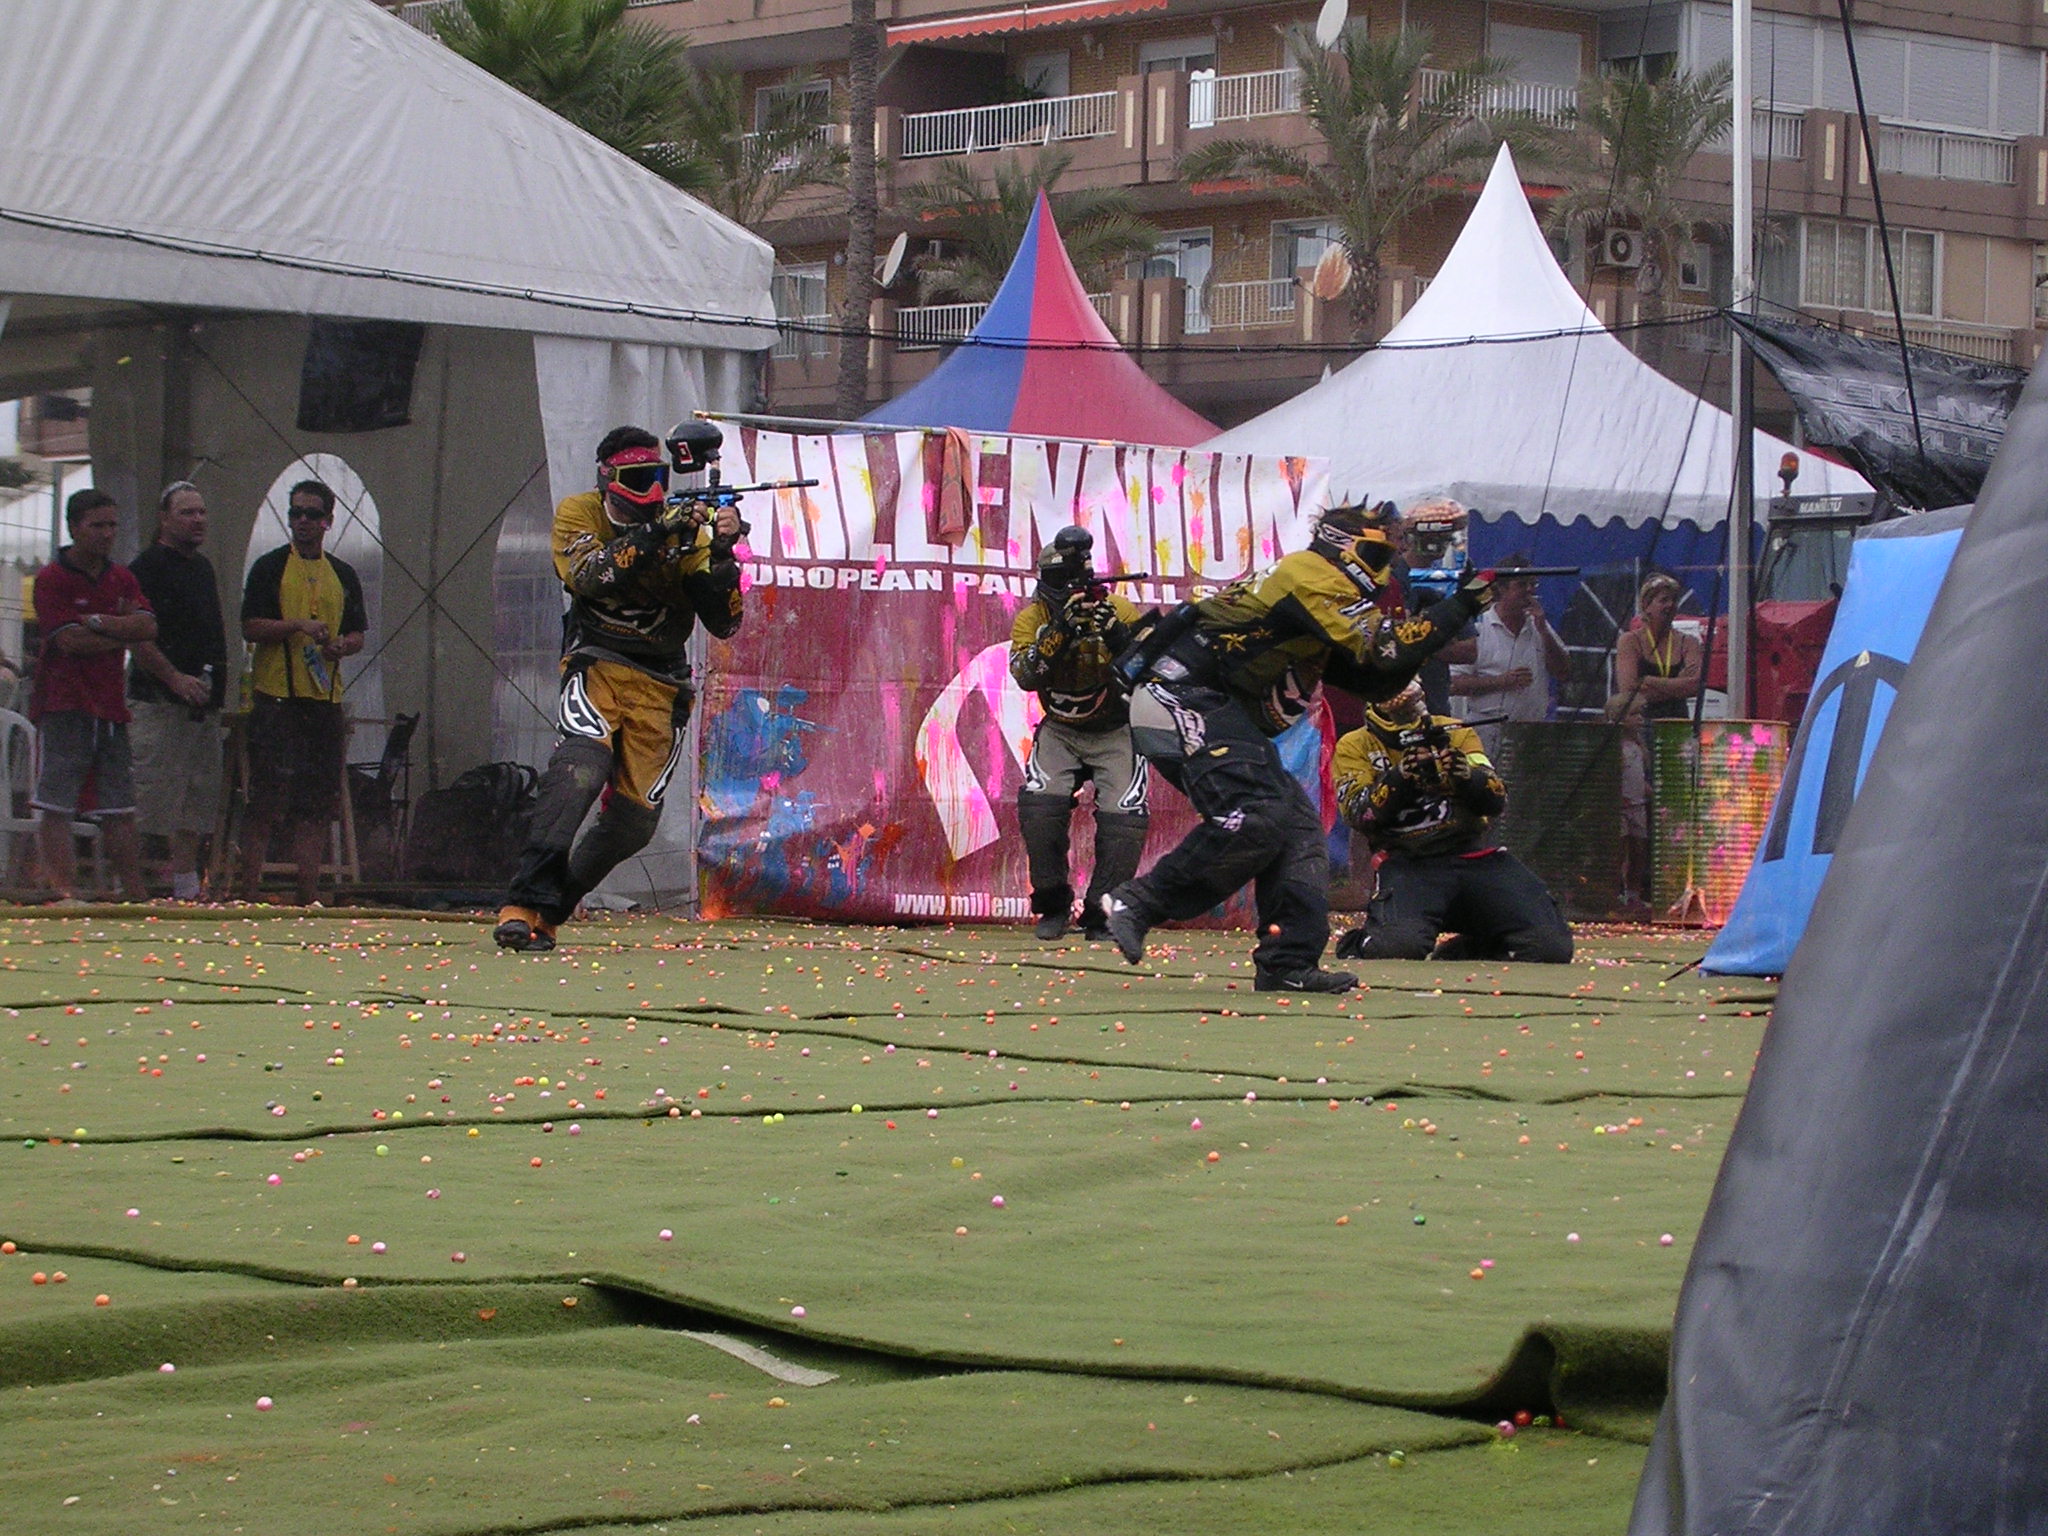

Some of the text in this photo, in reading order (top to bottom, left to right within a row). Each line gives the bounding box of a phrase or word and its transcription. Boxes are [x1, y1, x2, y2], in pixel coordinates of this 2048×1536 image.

[704, 419, 1328, 581] MILLENNIUM
[953, 571, 1183, 605] PAIALL
[894, 892, 1034, 918] www.millenn
